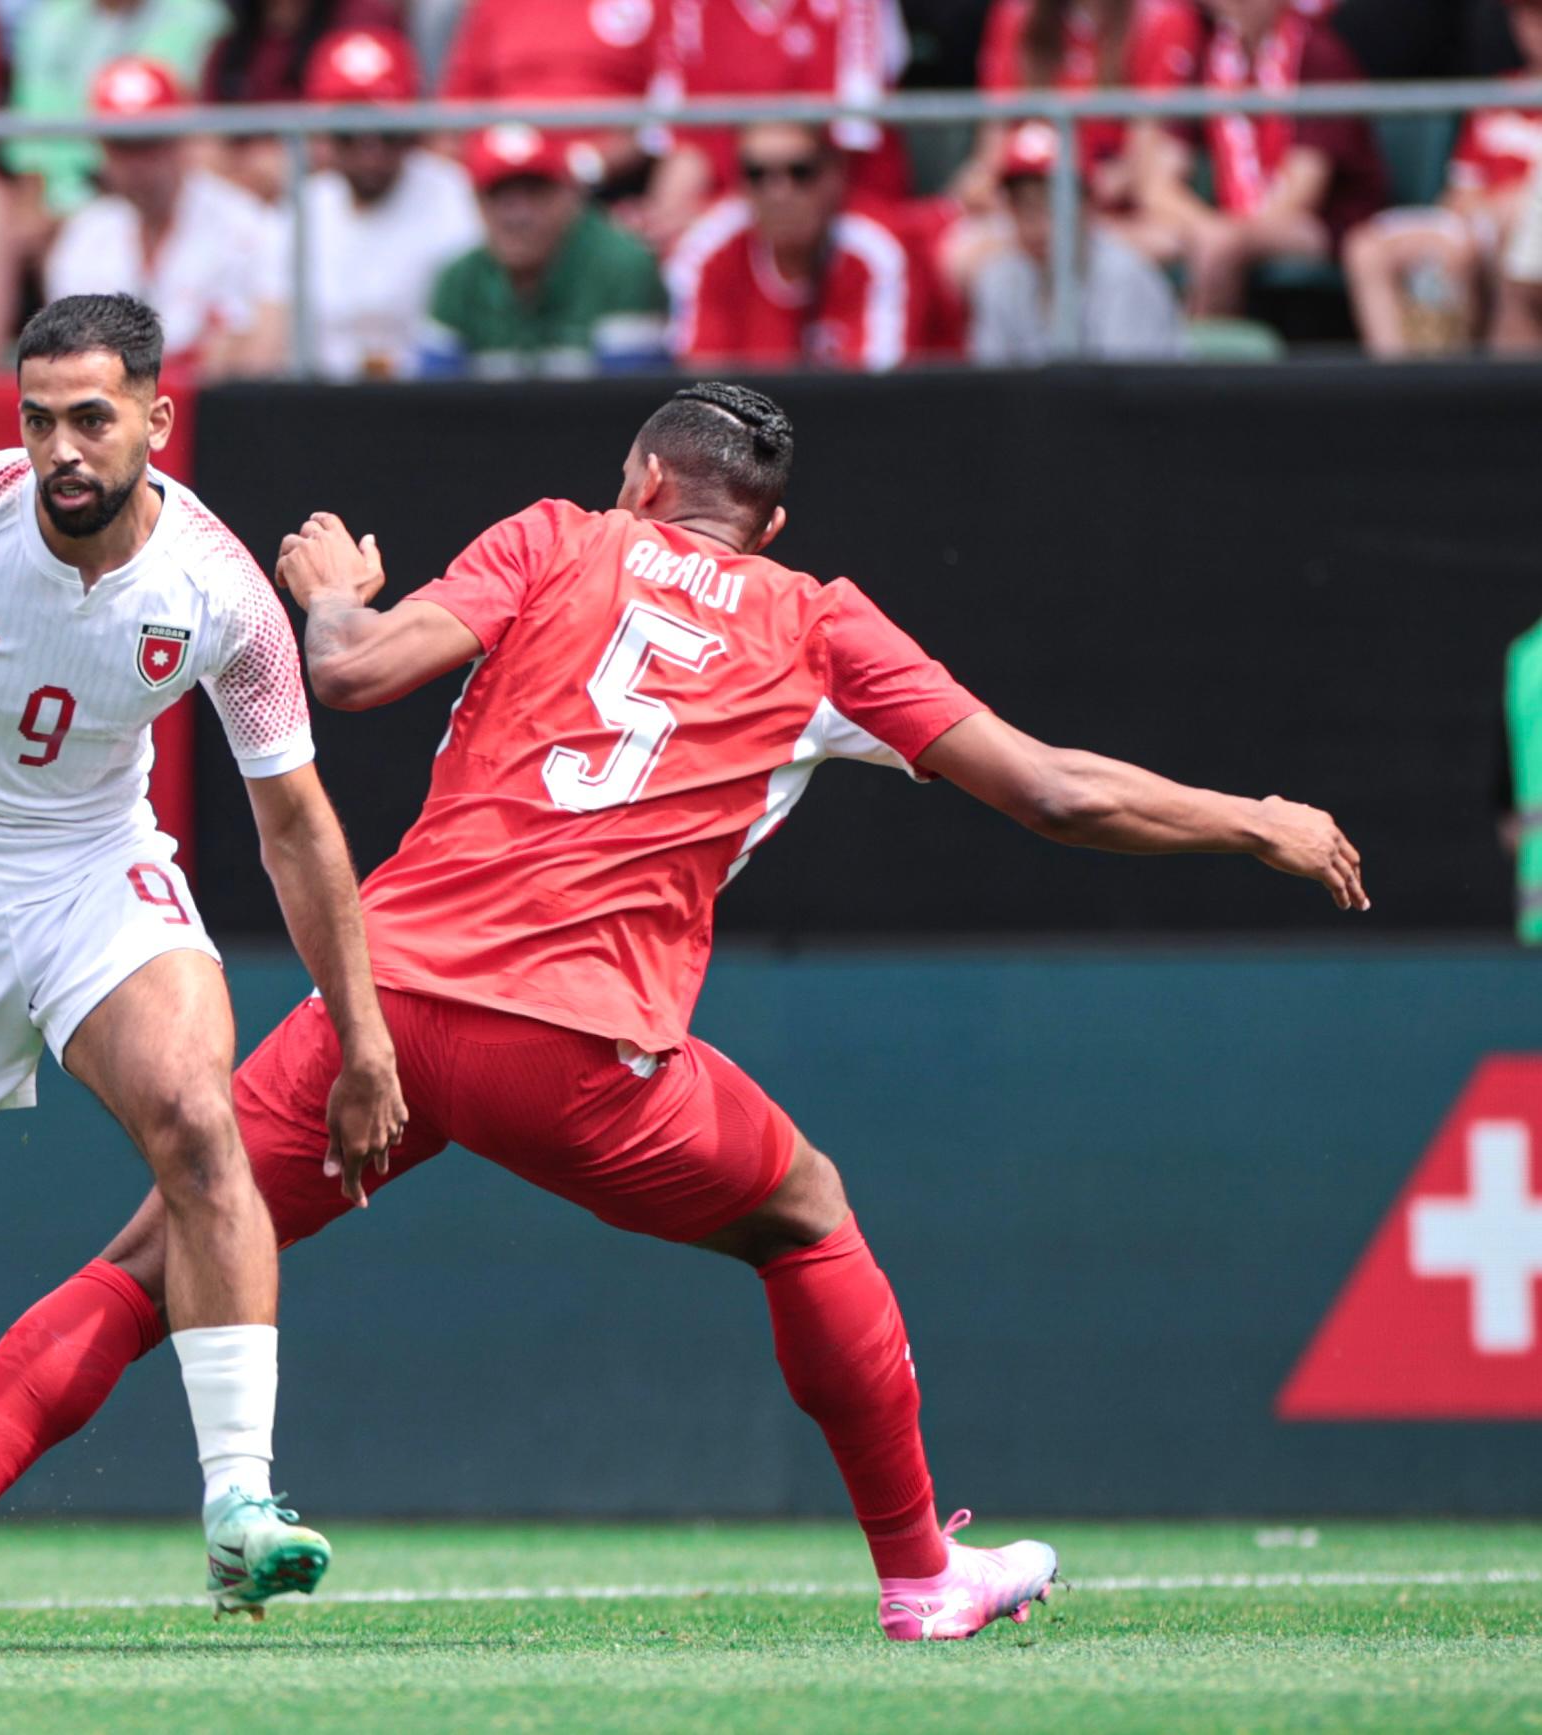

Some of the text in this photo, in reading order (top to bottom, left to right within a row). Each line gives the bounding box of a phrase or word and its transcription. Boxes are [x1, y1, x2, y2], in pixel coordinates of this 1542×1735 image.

[624, 539, 746, 614] AKANJI
[147, 626, 187, 639] JORDAN
[18, 684, 77, 768] 9
[541, 598, 727, 813] 5
[126, 863, 191, 925] 9
